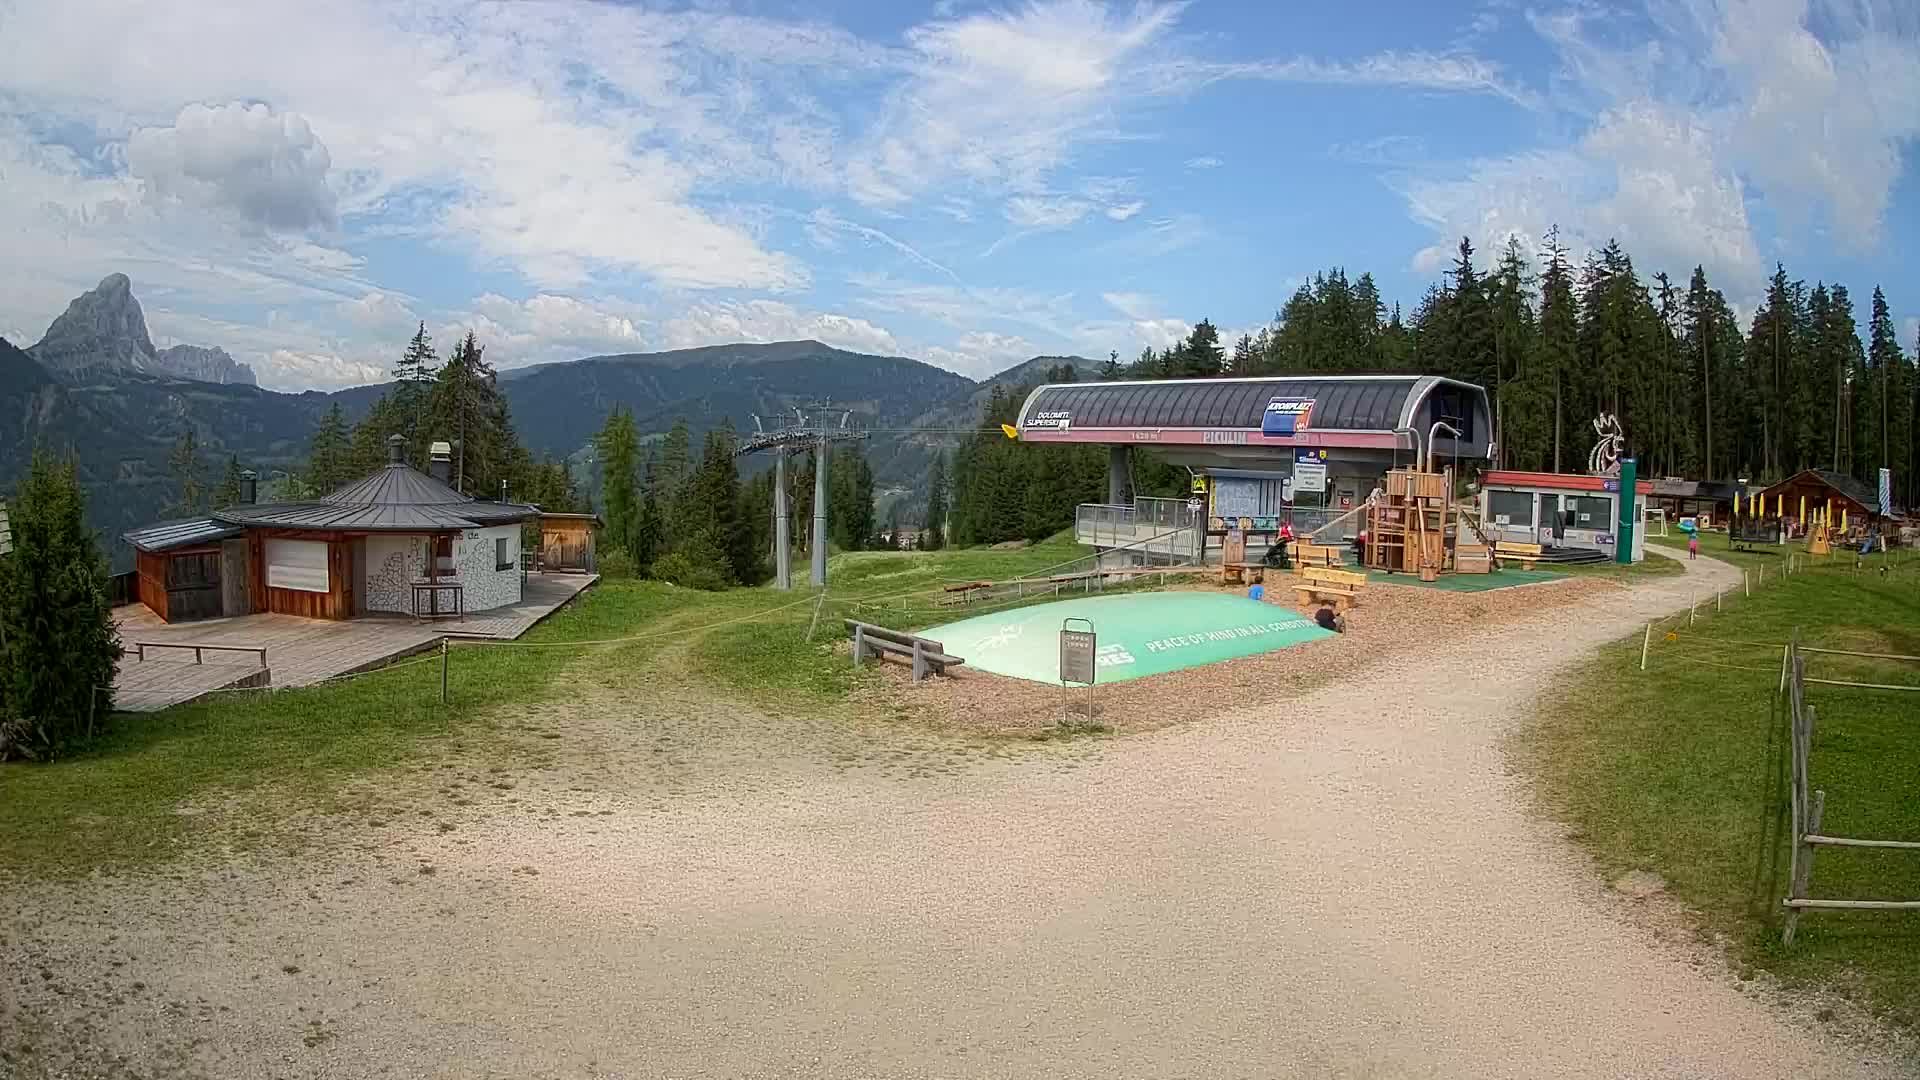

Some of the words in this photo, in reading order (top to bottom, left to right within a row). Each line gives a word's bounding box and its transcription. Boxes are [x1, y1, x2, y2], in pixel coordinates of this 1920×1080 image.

[1037, 411, 1070, 419] DOLOMITI
[1145, 635, 1191, 653] PEACE
[1187, 632, 1206, 645] OF
[1206, 629, 1236, 642] MIND
[1234, 627, 1251, 637] IN
[1250, 624, 1270, 636] ALL
